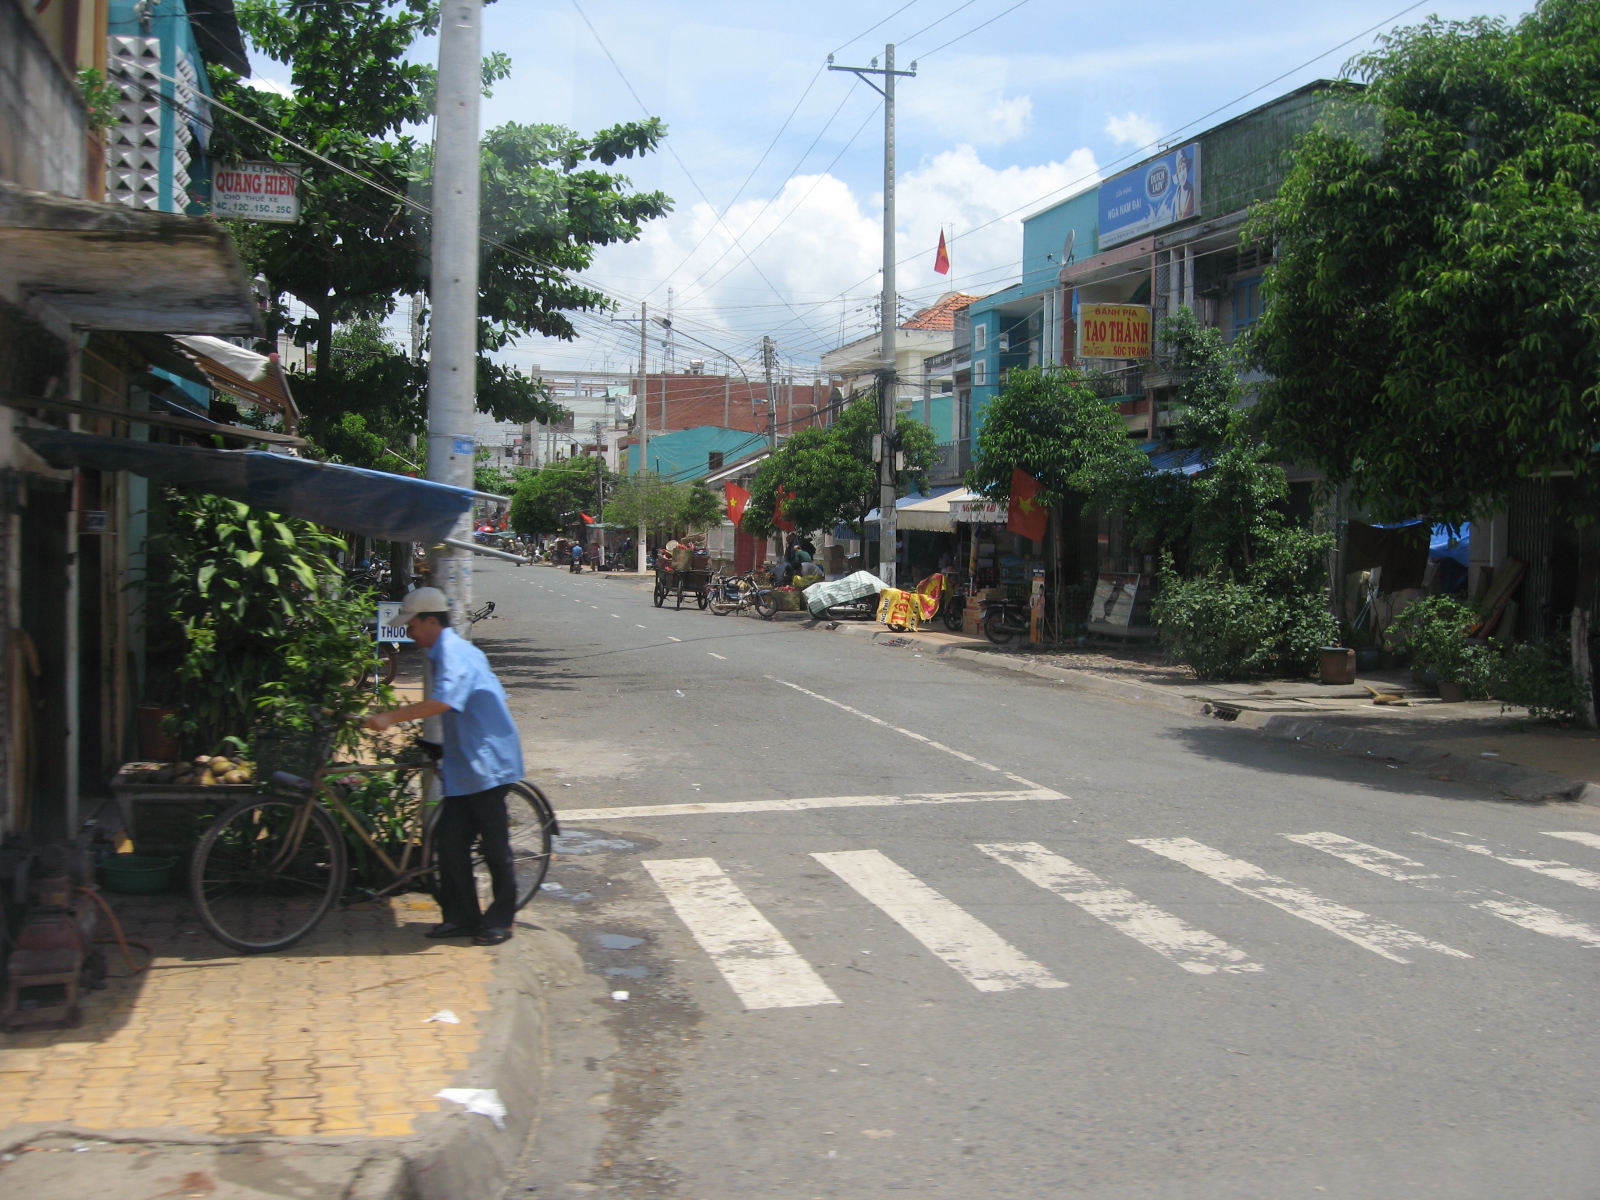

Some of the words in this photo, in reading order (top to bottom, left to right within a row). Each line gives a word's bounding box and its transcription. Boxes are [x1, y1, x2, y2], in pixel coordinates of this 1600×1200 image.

[216, 172, 262, 194] QUANG
[1150, 170, 1165, 184] DUTCH
[1152, 181, 1164, 193] LADY
[1107, 208, 1119, 220] NGA
[1119, 202, 1131, 215] NAM
[1095, 306, 1120, 316] BÁNH
[1122, 307, 1138, 317] PÍA
[1084, 319, 1107, 346] TẠO
[1109, 317, 1148, 343] THÀNH
[1113, 344, 1127, 356] SÓC
[891, 591, 911, 624] Tân
